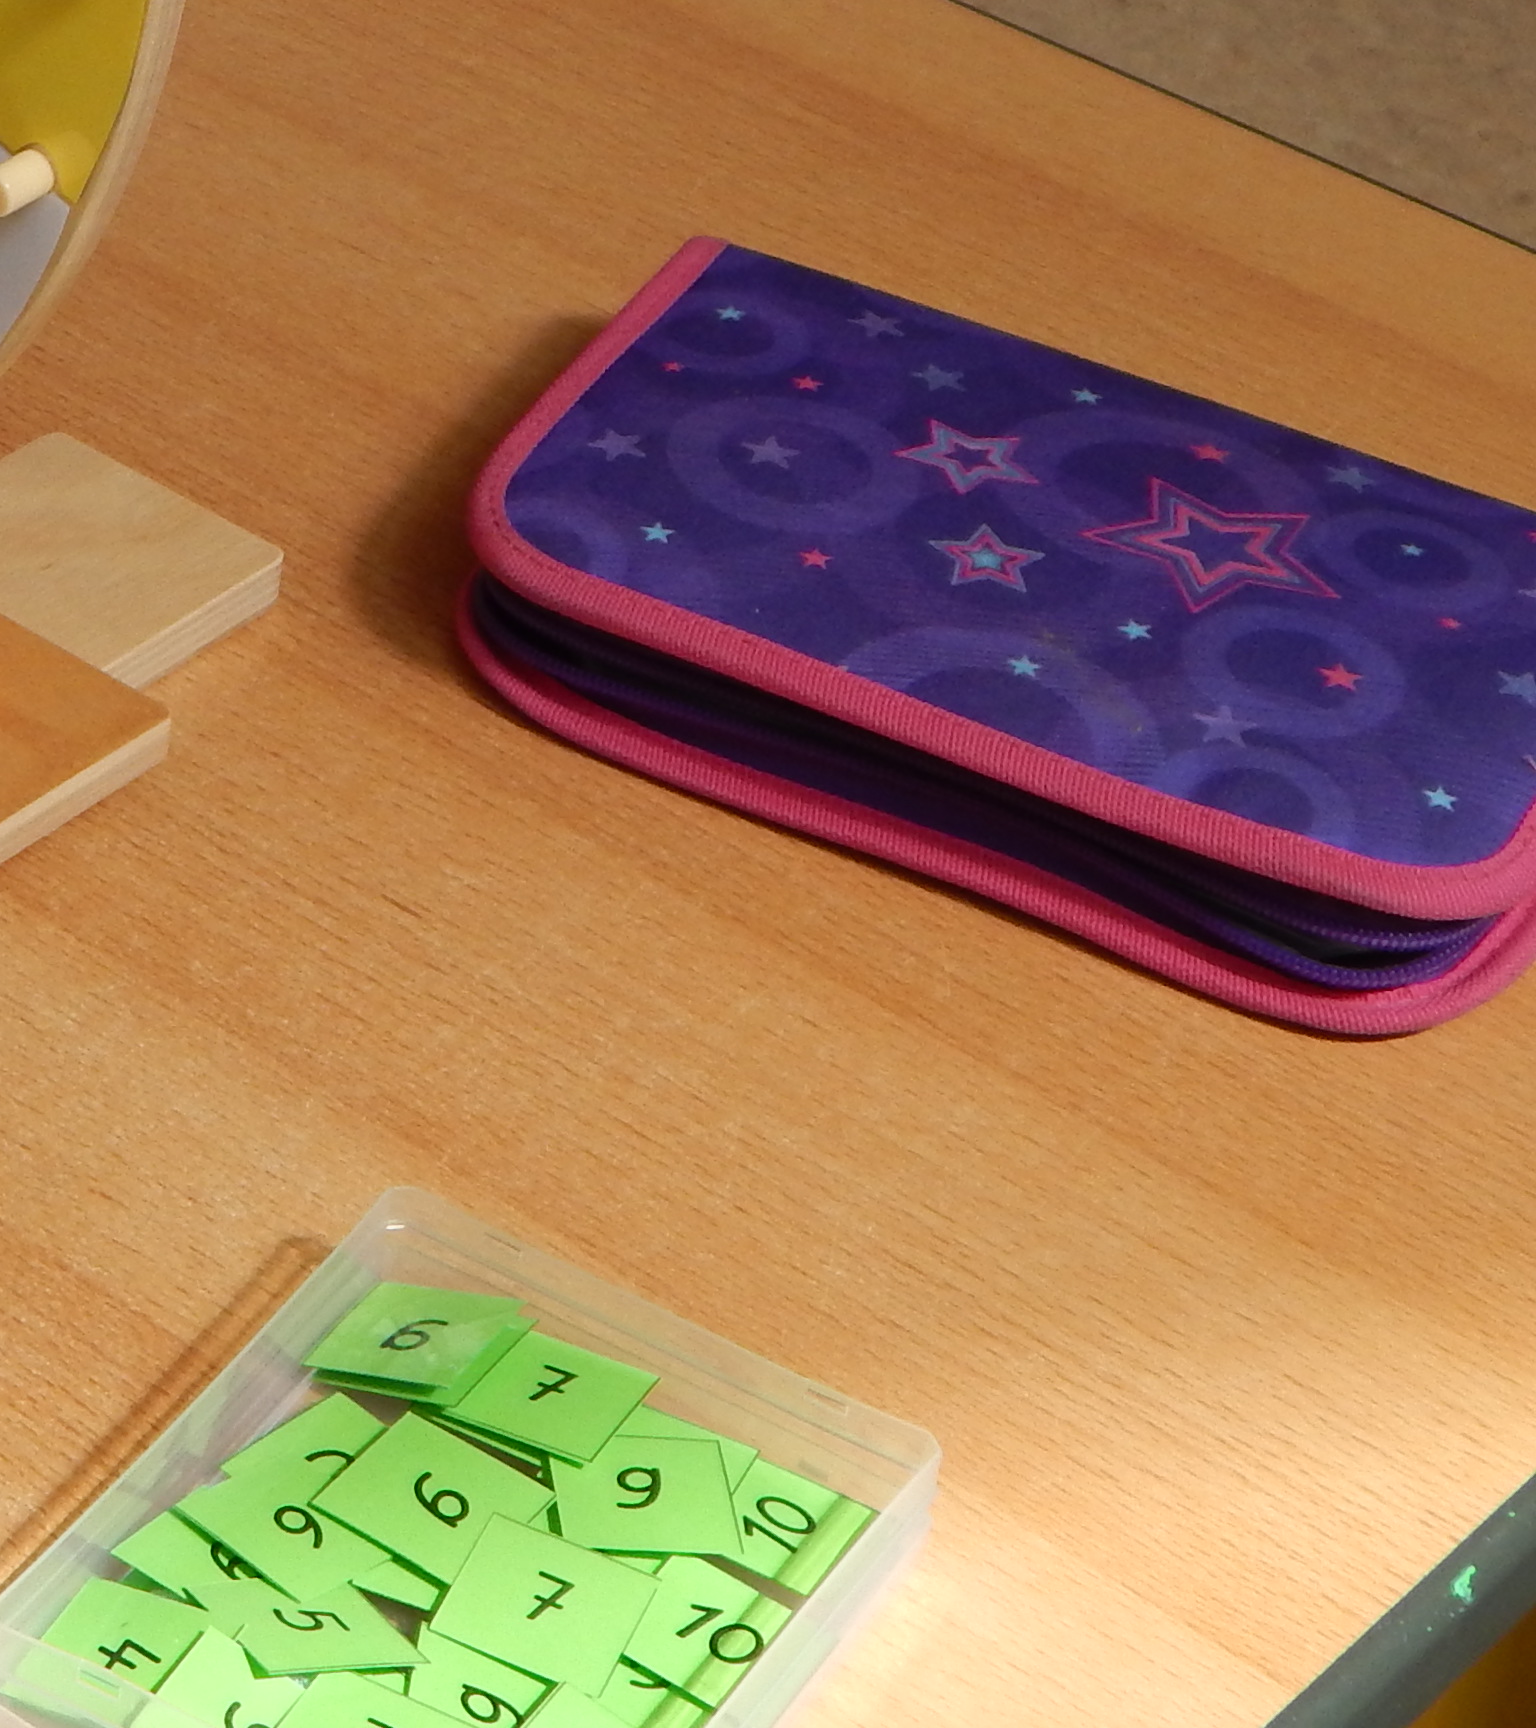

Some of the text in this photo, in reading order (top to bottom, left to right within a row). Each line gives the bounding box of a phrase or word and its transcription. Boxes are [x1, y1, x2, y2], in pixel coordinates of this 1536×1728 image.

[528, 1364, 579, 1401] 7
[616, 1467, 662, 1510] 9
[742, 1496, 818, 1555] 10
[526, 1570, 575, 1620] 7
[272, 1608, 351, 1632] 5
[675, 1604, 765, 1665] 10
